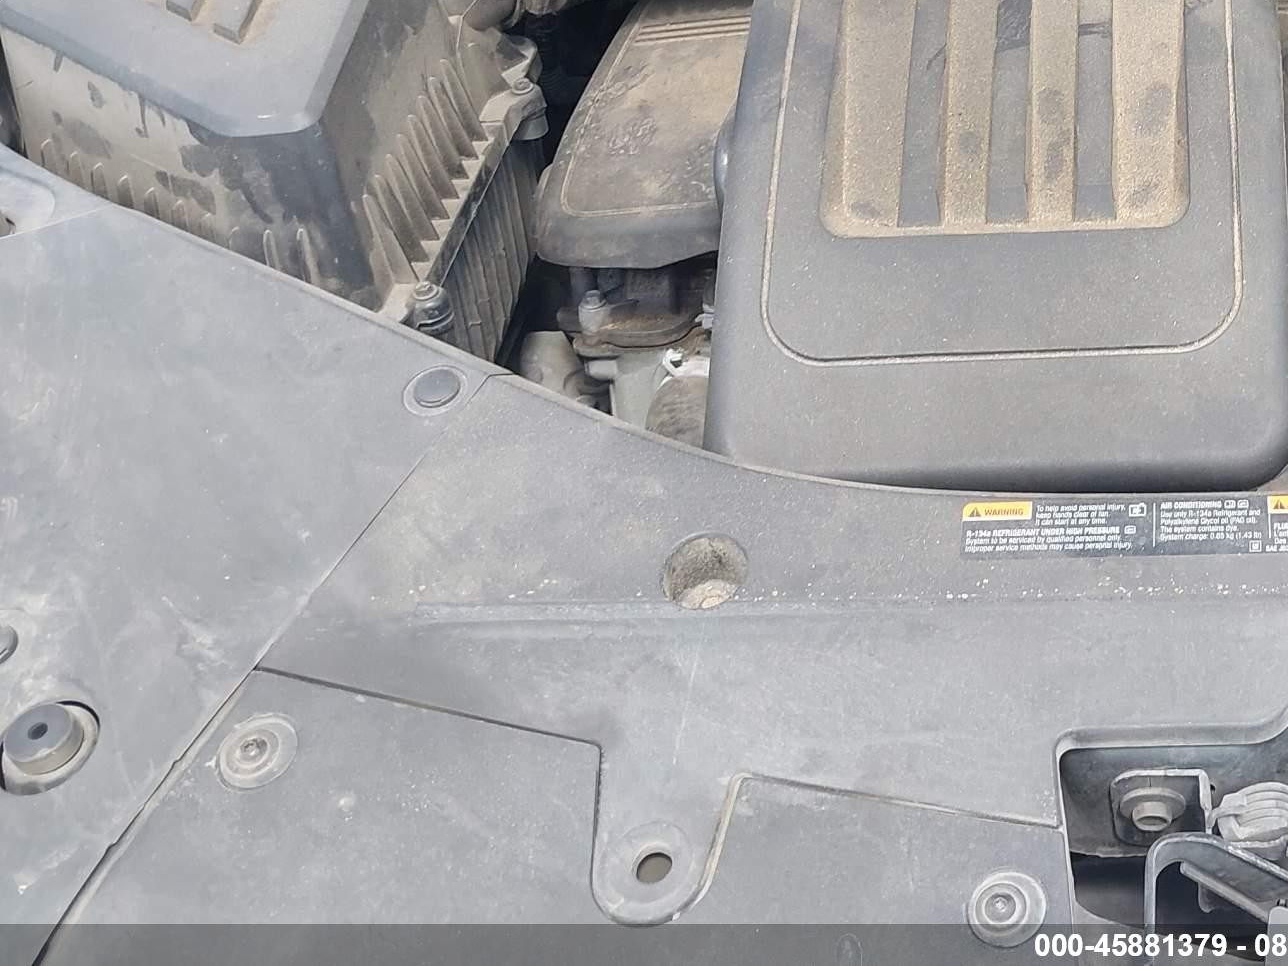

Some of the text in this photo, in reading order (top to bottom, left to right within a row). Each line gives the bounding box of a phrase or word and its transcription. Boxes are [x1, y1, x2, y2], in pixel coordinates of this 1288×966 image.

[1045, 505, 1058, 513] help
[1160, 501, 1172, 509] AIR
[984, 508, 1024, 517] WARNING
[1041, 527, 1064, 536] UNDER
[966, 537, 990, 546] System
[1050, 544, 1063, 552] may
